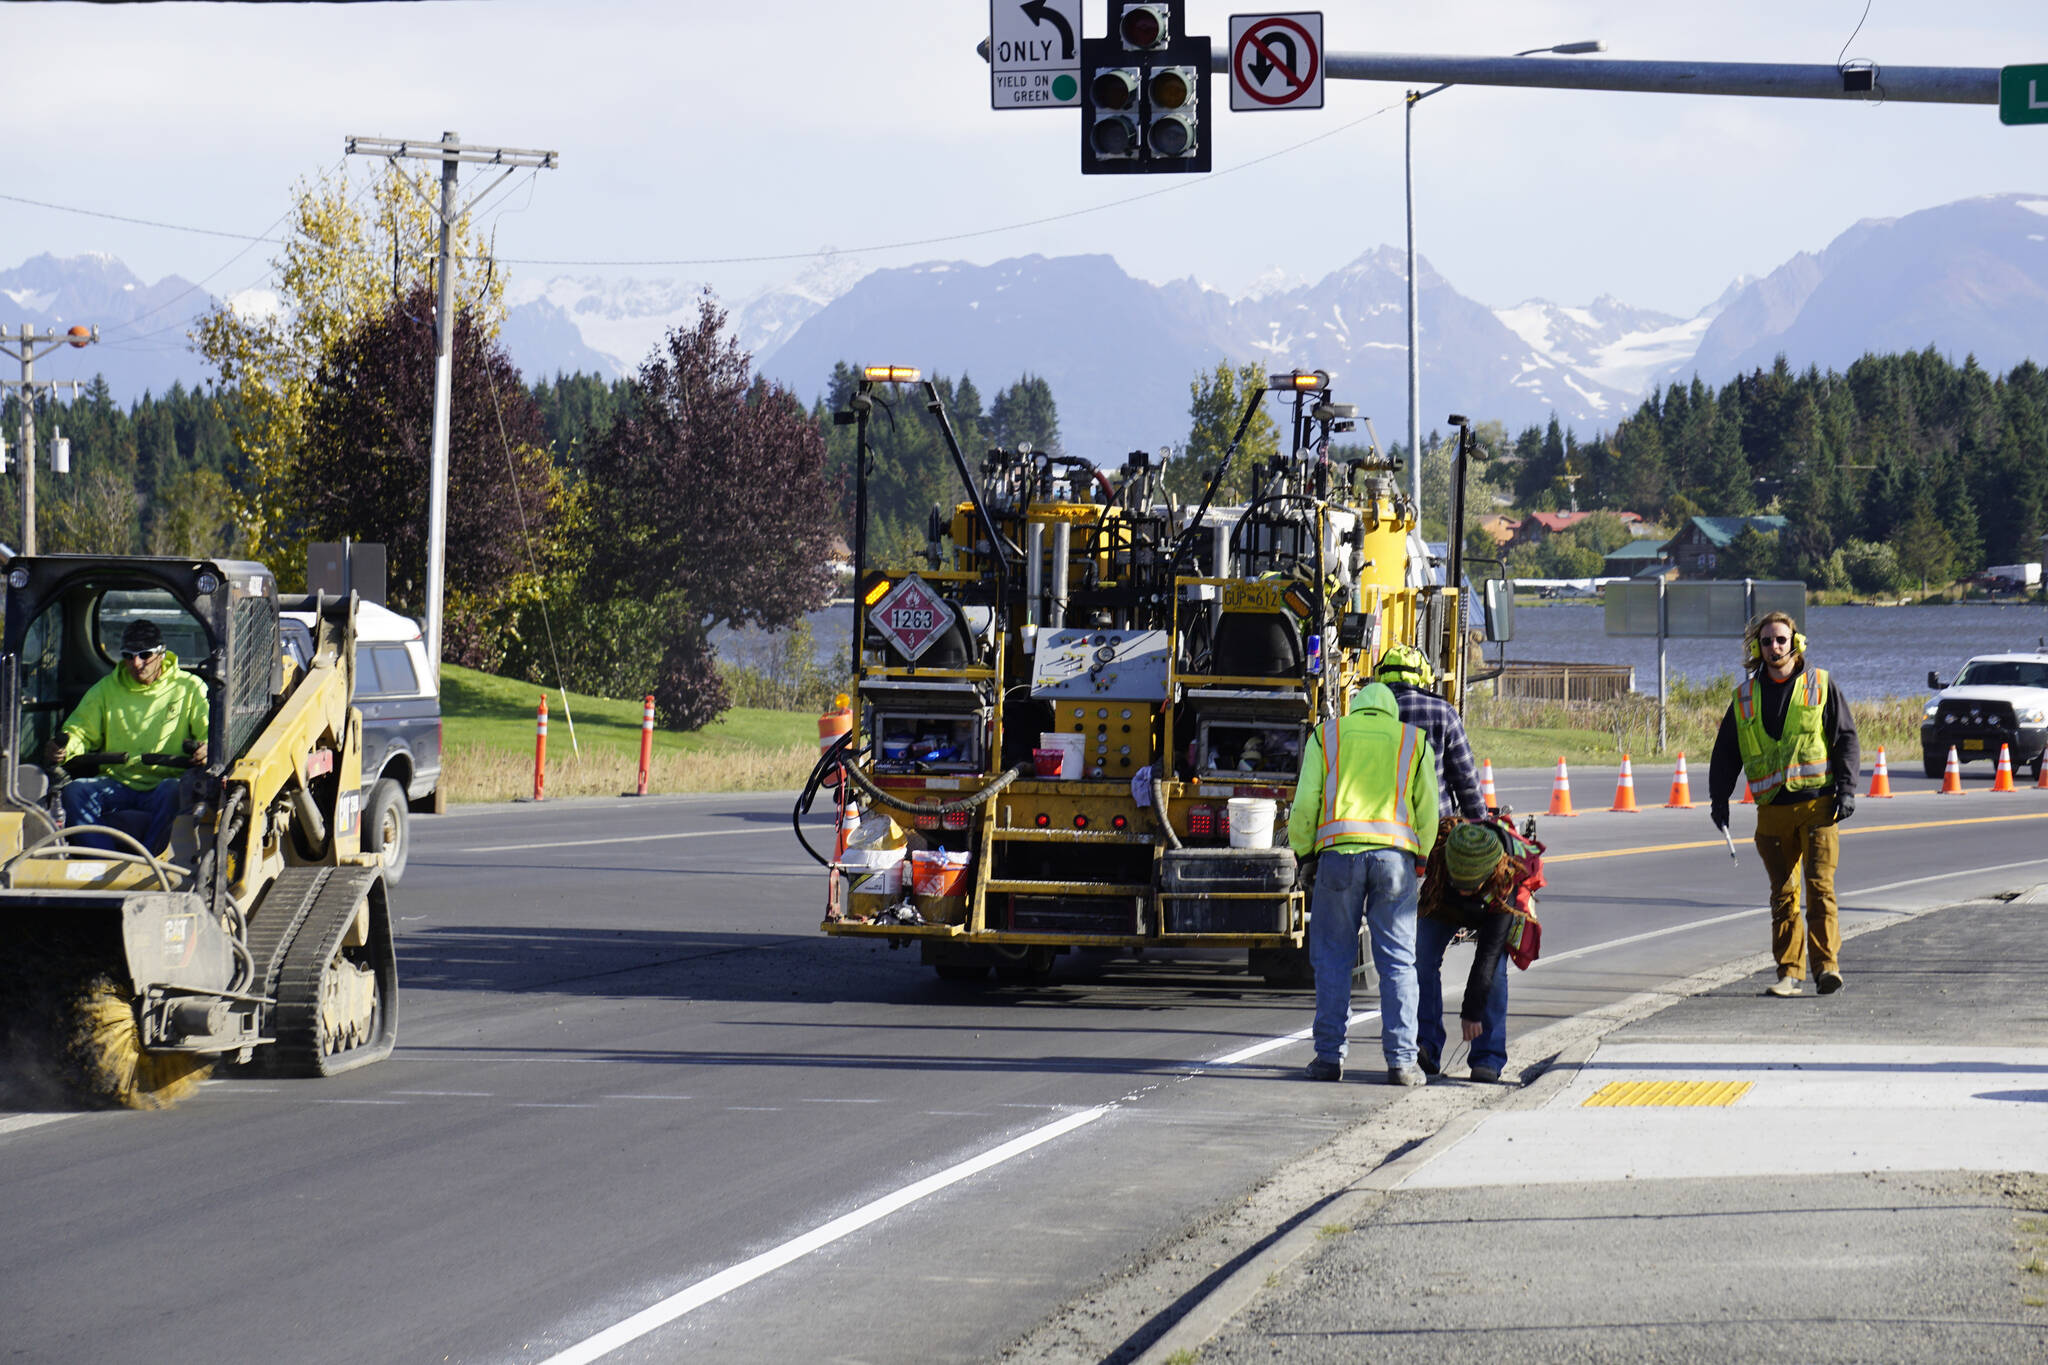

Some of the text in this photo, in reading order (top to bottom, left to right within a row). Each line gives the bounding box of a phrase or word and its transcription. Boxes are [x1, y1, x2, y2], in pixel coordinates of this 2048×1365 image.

[1000, 40, 1052, 62] ONLY
[997, 75, 1049, 88] YIELD ON
[1013, 90, 1049, 102] GREEN
[1256, 591, 1278, 607] 612
[893, 610, 932, 629] 1263
